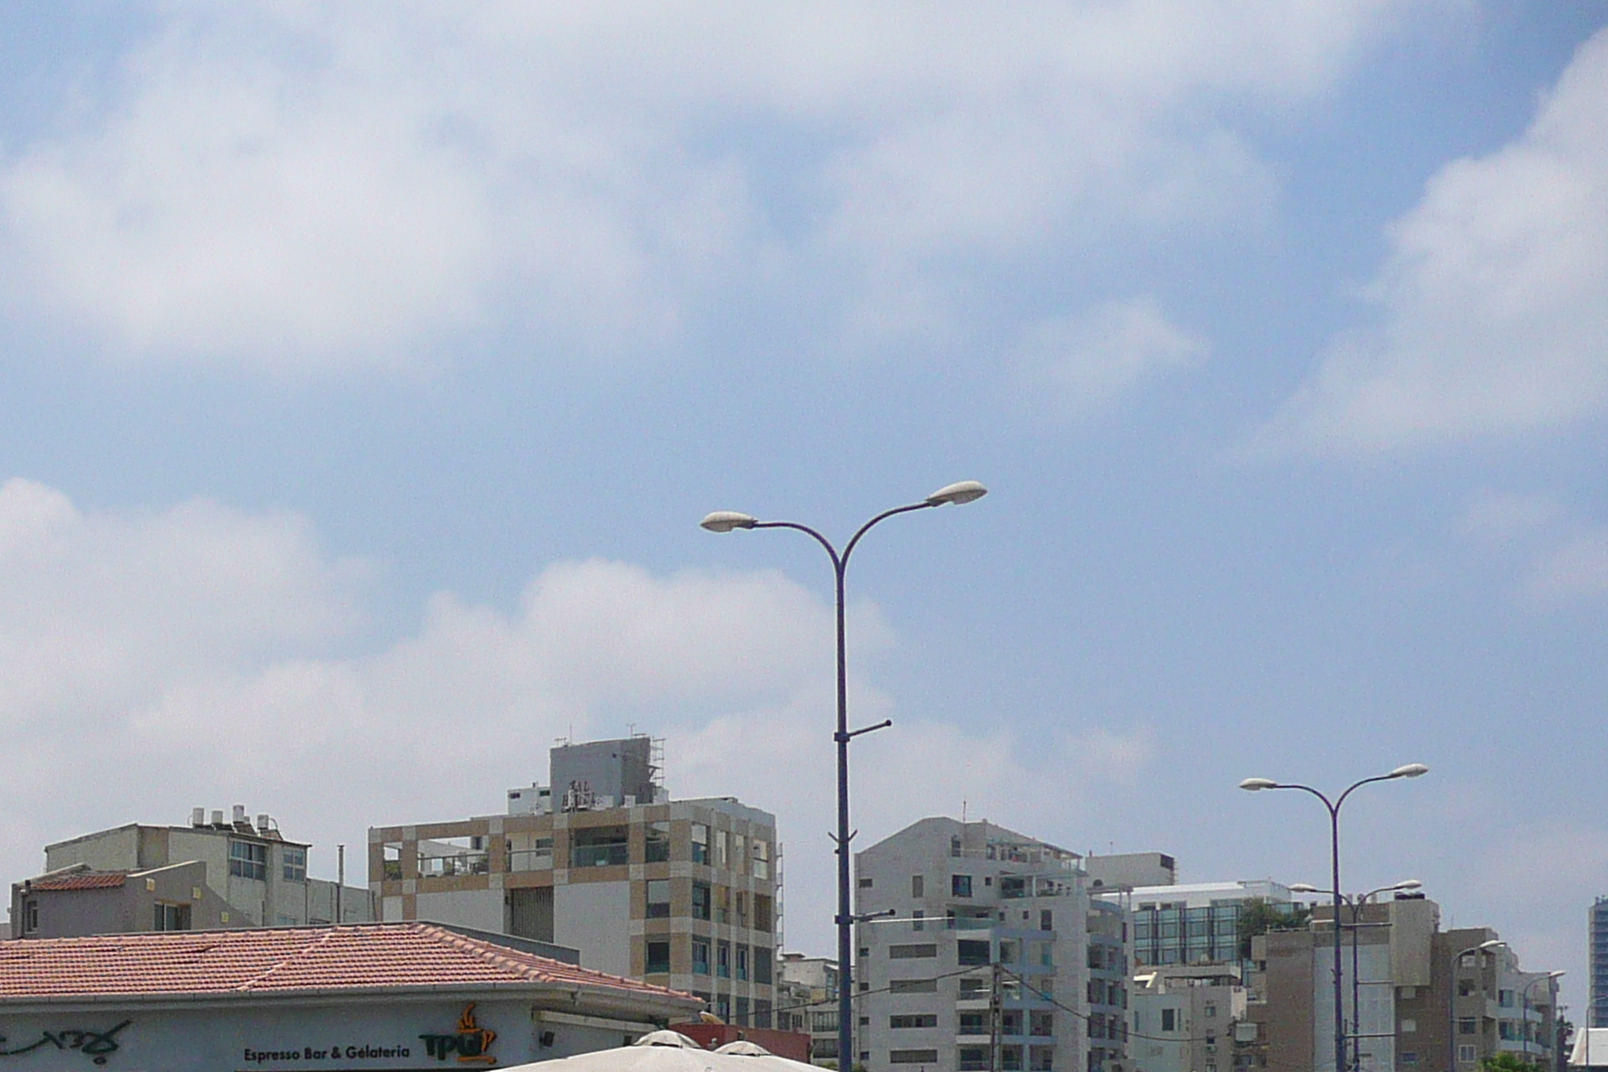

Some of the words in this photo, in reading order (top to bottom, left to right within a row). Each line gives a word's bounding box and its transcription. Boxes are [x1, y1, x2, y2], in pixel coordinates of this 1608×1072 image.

[244, 1048, 300, 1064] Espresso
[304, 1047, 327, 1060] Bar
[331, 1047, 341, 1059] &
